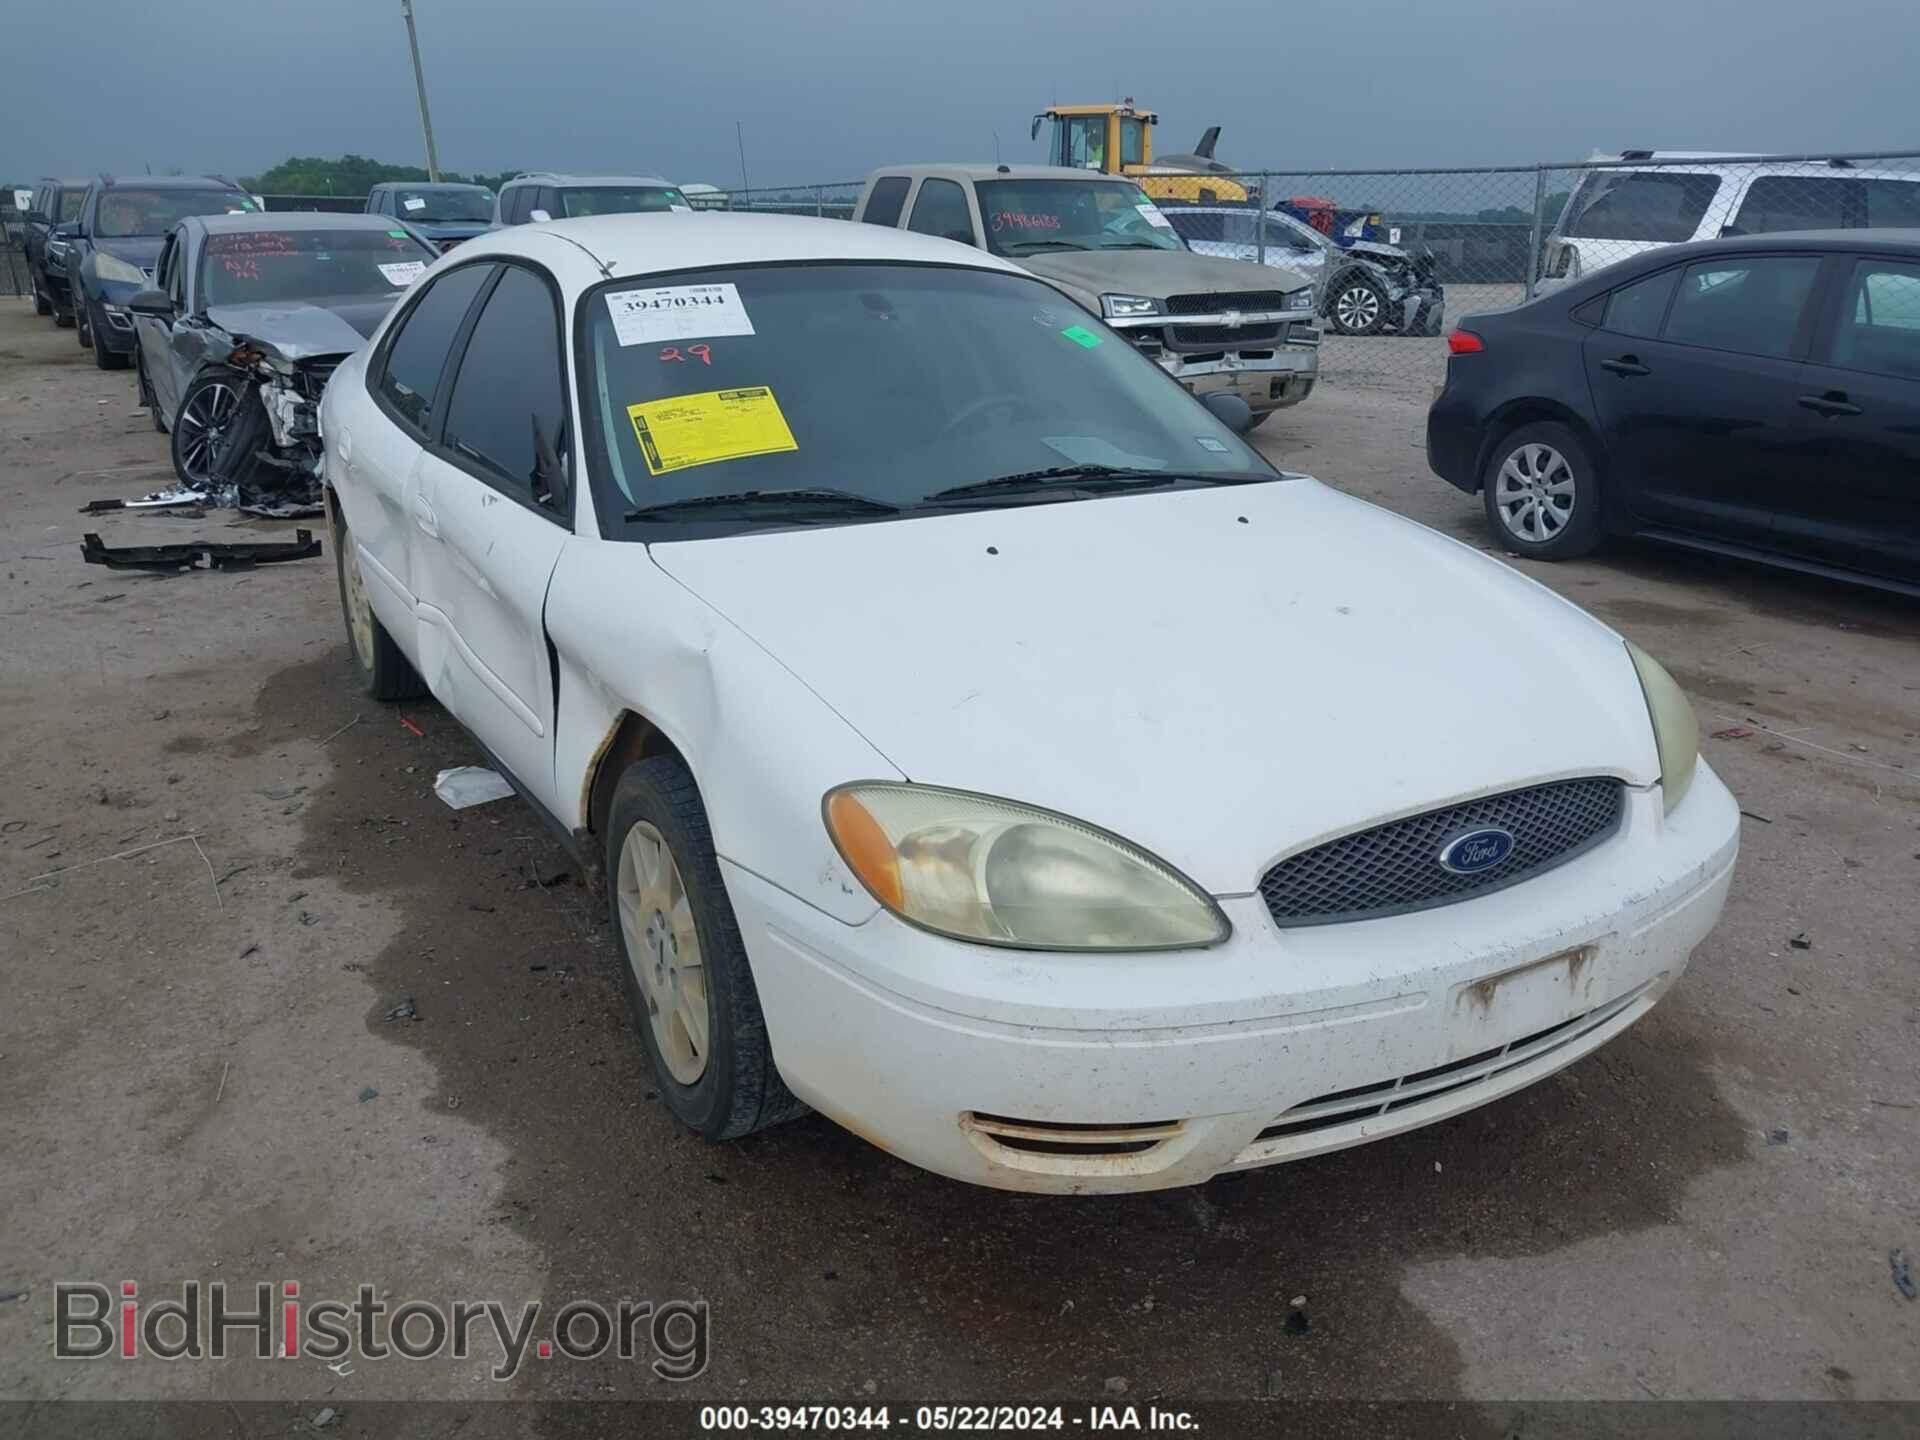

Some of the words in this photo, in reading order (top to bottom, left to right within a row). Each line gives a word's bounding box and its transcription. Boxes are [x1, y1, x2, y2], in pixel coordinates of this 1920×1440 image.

[623, 295, 725, 313] 39470344
[660, 344, 711, 365] 29
[1461, 838, 1499, 865] Ford
